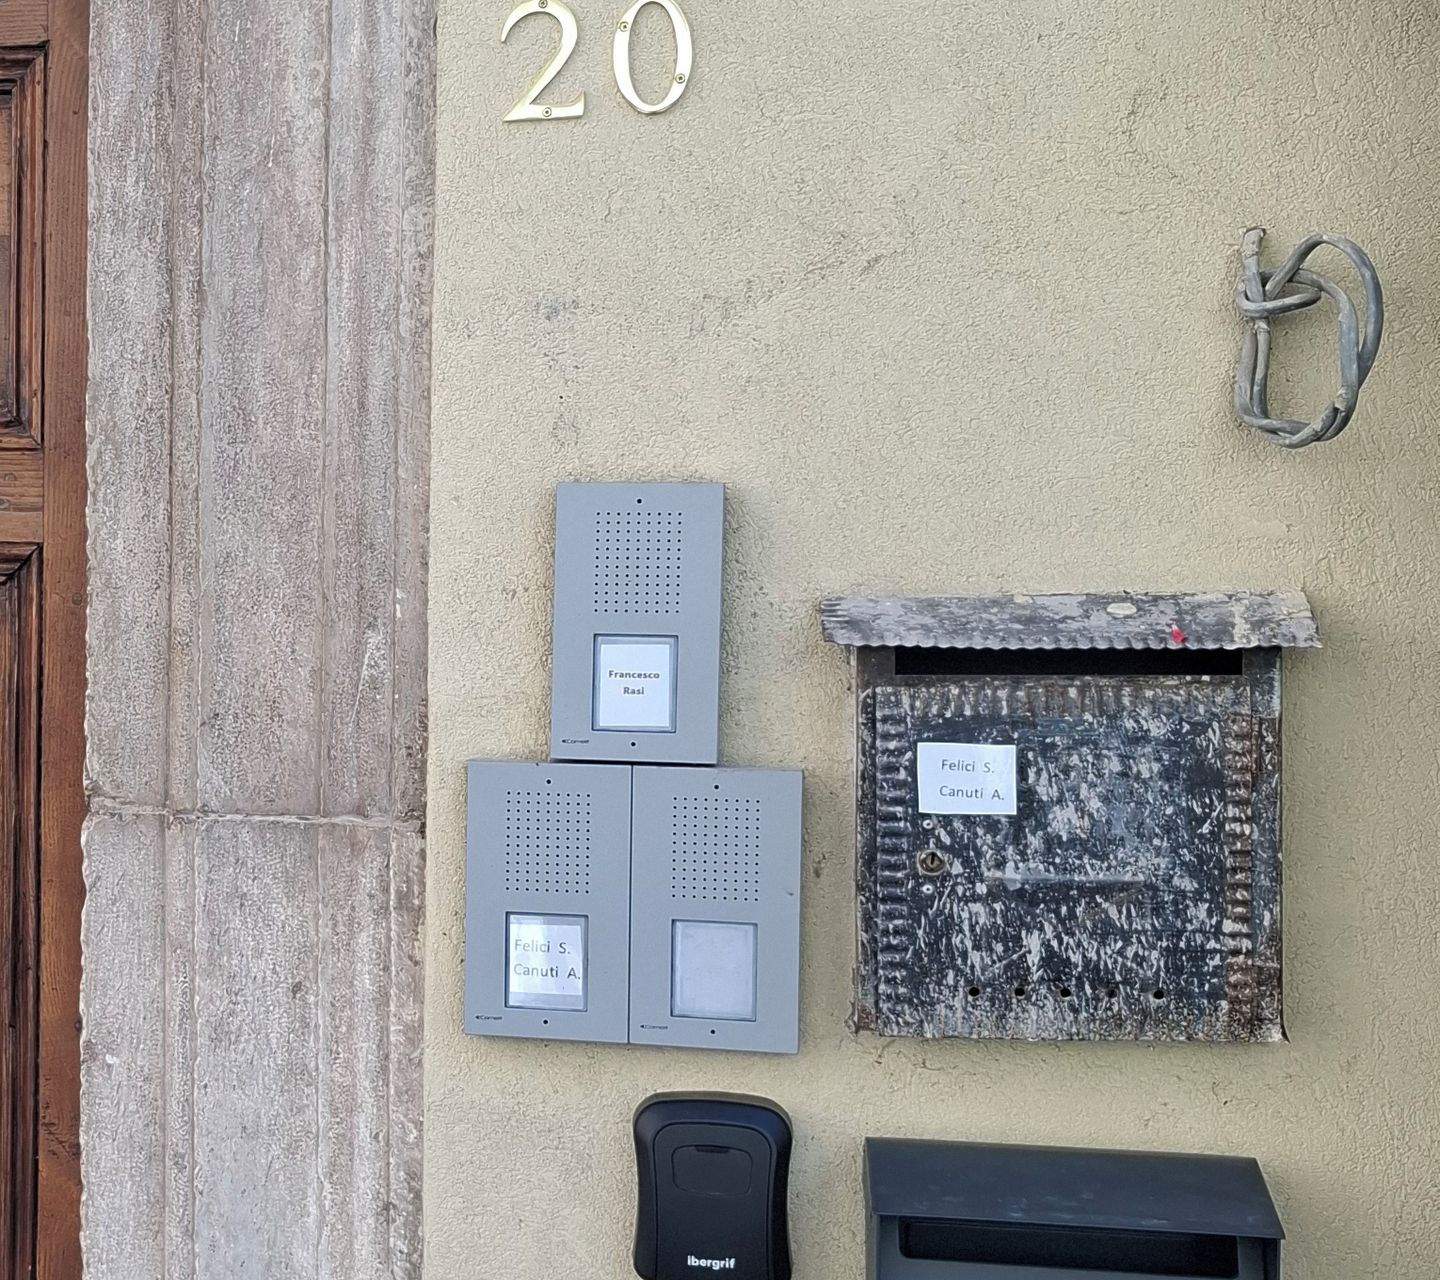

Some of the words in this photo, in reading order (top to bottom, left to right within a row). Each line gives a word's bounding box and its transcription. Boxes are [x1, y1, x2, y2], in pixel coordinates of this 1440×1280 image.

[607, 669, 661, 680] Francesco
[622, 685, 645, 696] Rasi
[940, 758, 976, 773] Felici
[983, 761, 995, 774] S.
[938, 784, 984, 800] Canuti
[990, 788, 1005, 801] A.
[514, 938, 551, 953] Felici
[558, 941, 571, 955] S.
[513, 962, 559, 978] Canuti
[566, 966, 581, 980] A.
